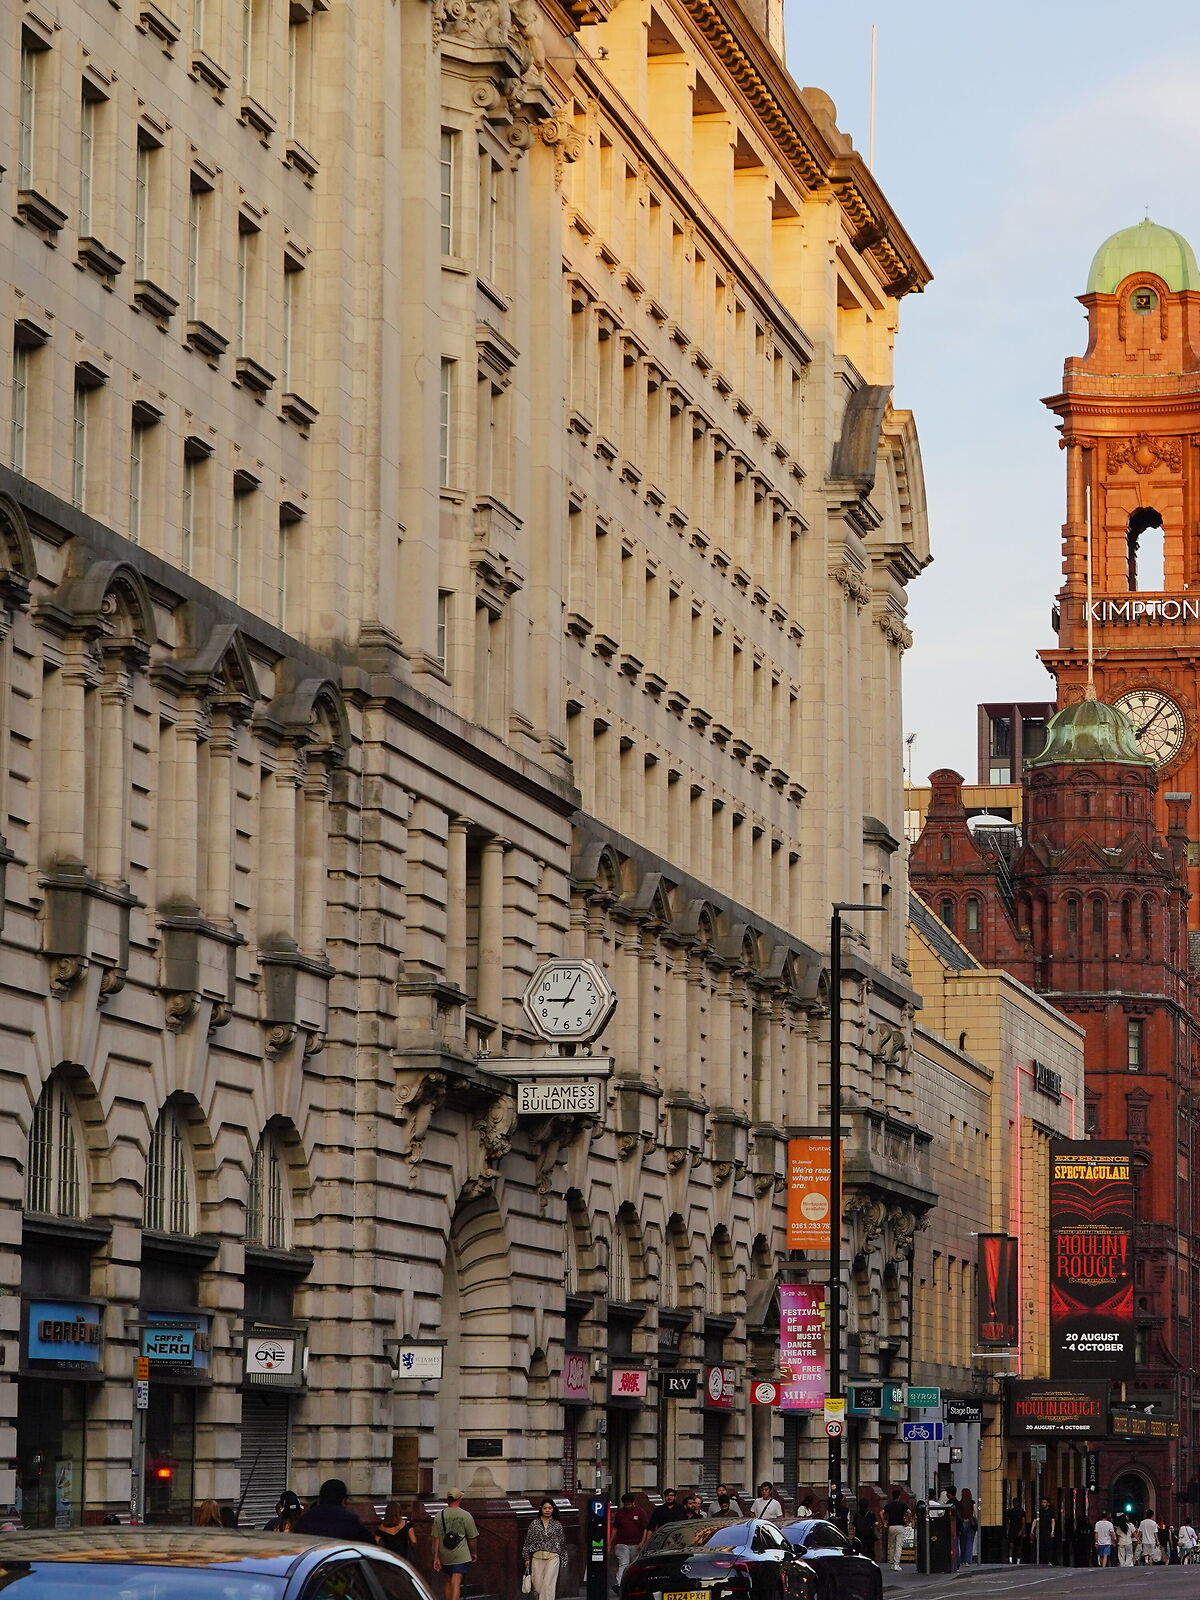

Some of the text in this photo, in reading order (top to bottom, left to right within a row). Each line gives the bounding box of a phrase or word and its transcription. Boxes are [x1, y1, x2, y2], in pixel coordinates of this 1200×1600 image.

[1084, 600, 1200, 620] KIMPTON
[563, 971, 572, 979] 12
[542, 982, 551, 991] 10
[586, 982, 592, 991] 2
[538, 996, 545, 1004] 9
[591, 996, 596, 1004] 3
[542, 1009, 548, 1017] 8
[585, 1009, 592, 1017] 4
[553, 1018, 558, 1026] 7
[564, 1021, 570, 1029] 6
[576, 1018, 582, 1026] 5
[523, 1088, 540, 1098] ST.
[522, 1099, 595, 1111] BUILDINGS
[1055, 1166, 1129, 1180] SPECTACULAR!
[1057, 1235, 1117, 1255] MOULIN
[1066, 1333, 1119, 1341] 20 AUGUST
[146, 1344, 190, 1354] NERO
[1069, 1343, 1076, 1351] 4
[1078, 1343, 1124, 1352] OCTOBER
[950, 1406, 979, 1415] Stage Door
[1016, 1400, 1102, 1416] MOULIN ROUGE!
[595, 1503, 603, 1514] P
